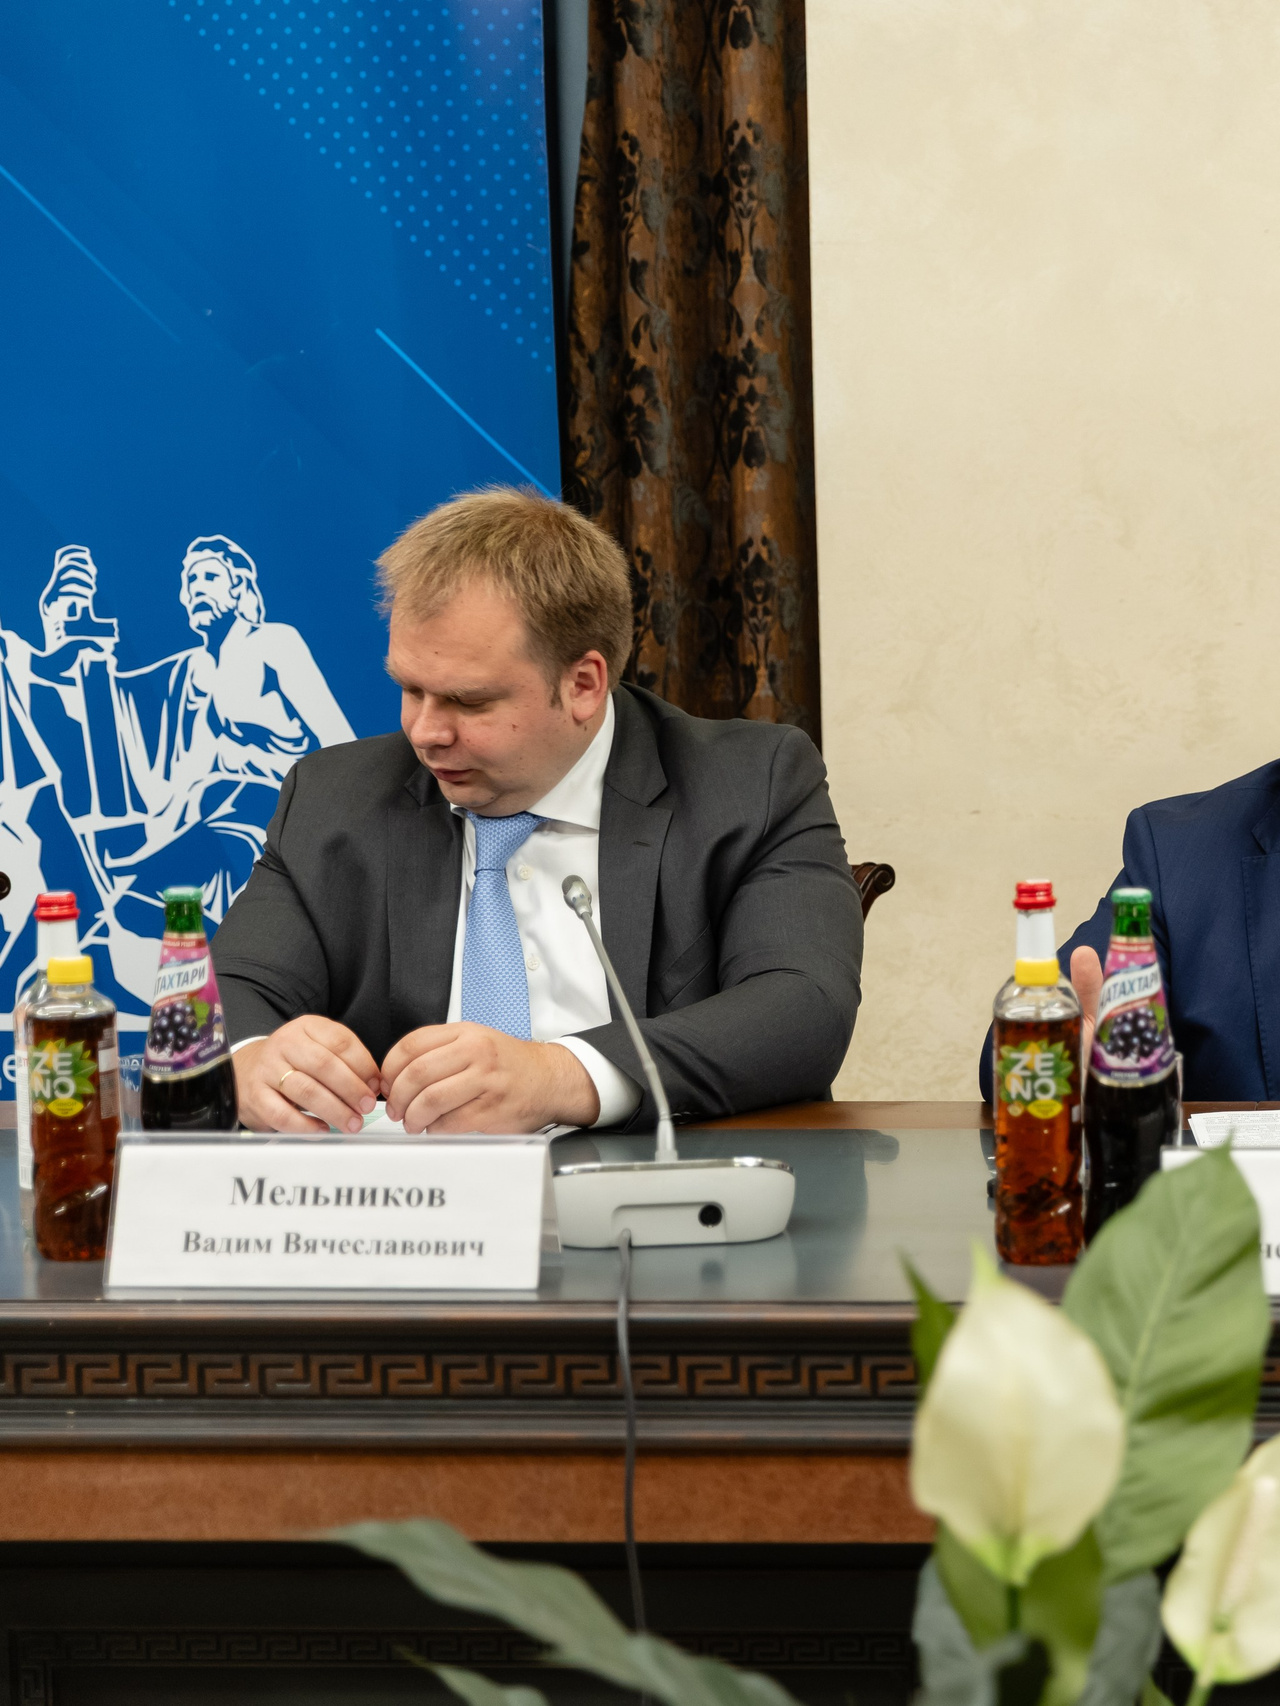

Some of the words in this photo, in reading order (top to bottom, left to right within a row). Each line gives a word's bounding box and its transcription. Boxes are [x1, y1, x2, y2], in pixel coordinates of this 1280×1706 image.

[154, 965, 206, 996] ТАХТАРИ
[229, 1176, 447, 1208] Мельников
[182, 1230, 273, 1256] Вадим
[282, 1231, 485, 1257] Вячеславович
